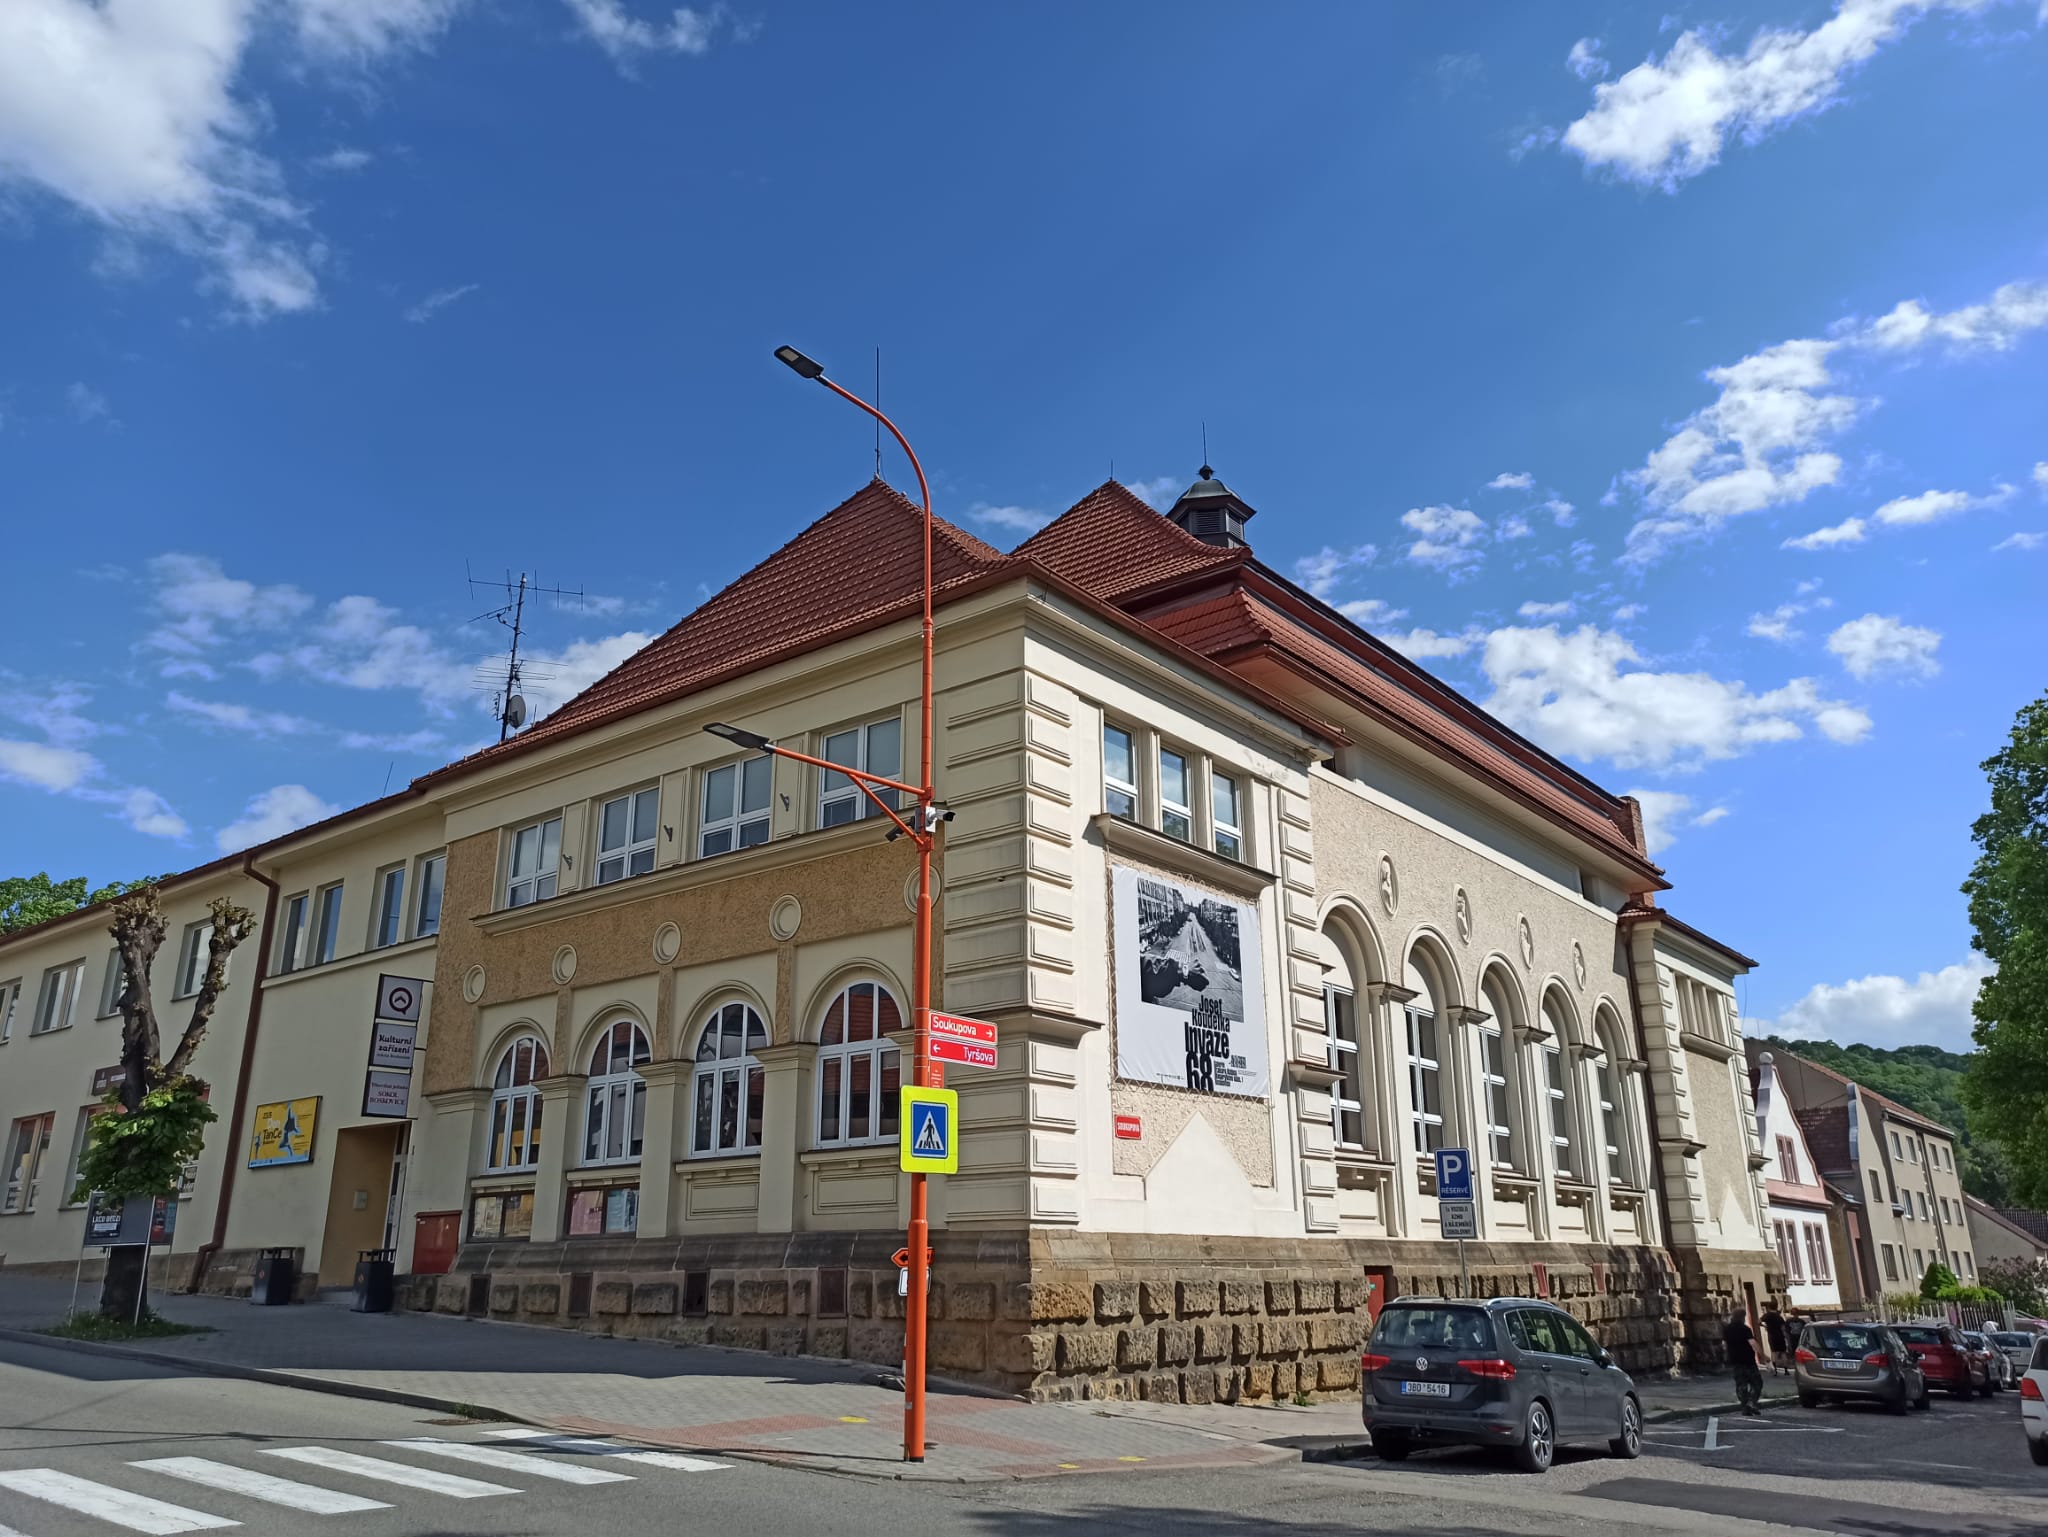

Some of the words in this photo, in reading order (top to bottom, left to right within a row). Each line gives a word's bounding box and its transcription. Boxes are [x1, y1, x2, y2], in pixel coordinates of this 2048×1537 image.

[1199, 994, 1223, 1014] Josef
[933, 1015, 977, 1036] Soukupova
[1192, 1008, 1230, 1033] Koudelka
[378, 1034, 413, 1046] Kulturní
[378, 1044, 411, 1054] zařízení
[1184, 1021, 1230, 1059] Invaze
[963, 1046, 994, 1063] Tyršova
[1186, 1051, 1214, 1092] 68
[1442, 1154, 1462, 1185] P
